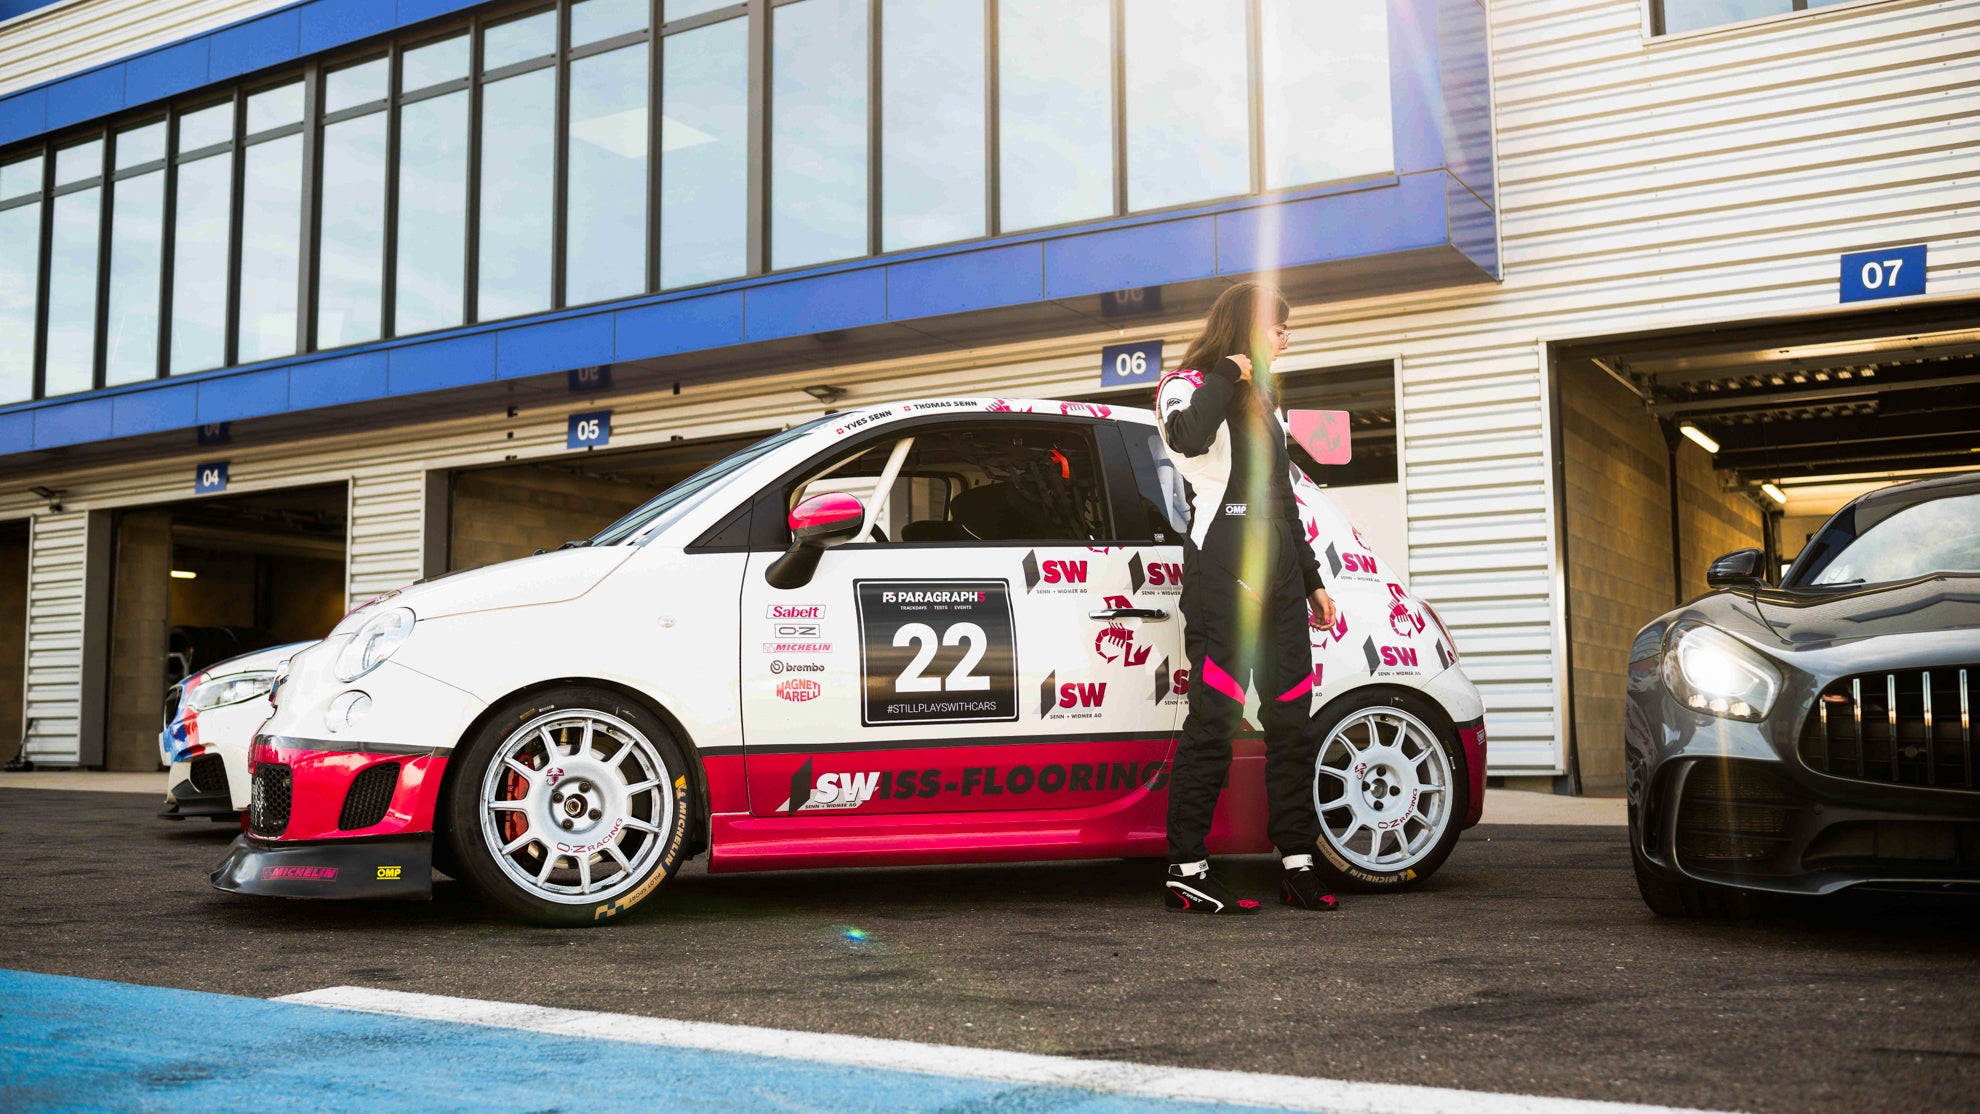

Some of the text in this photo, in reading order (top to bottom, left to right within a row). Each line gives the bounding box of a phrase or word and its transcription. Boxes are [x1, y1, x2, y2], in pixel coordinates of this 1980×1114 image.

[1861, 259, 1903, 289] 07
[1116, 351, 1147, 376] 06
[913, 401, 952, 410] THOMAS
[577, 419, 600, 441] 05
[844, 410, 892, 431] YVES SENN
[202, 468, 219, 487] 04
[1225, 504, 1247, 514] OMP
[1041, 559, 1088, 584] SW
[1147, 562, 1185, 586] SW
[1342, 552, 1378, 575] SW
[898, 591, 986, 603] PARAGRAPH5
[772, 605, 820, 618] Sabelt
[892, 621, 991, 693] 22
[1380, 645, 1419, 667] SW
[786, 662, 825, 672] brembo
[1058, 682, 1107, 709] SW
[886, 701, 997, 714] #STILLPLAYSWITHCARS
[1400, 788, 1418, 824] RACING
[587, 817, 623, 852] RACING
[664, 800, 687, 867] MICHELIN
[272, 867, 338, 879] MICHELIN
[376, 868, 402, 878] OMP
[1349, 868, 1399, 884] MICHELIN
[1182, 890, 1203, 904] FIRST
